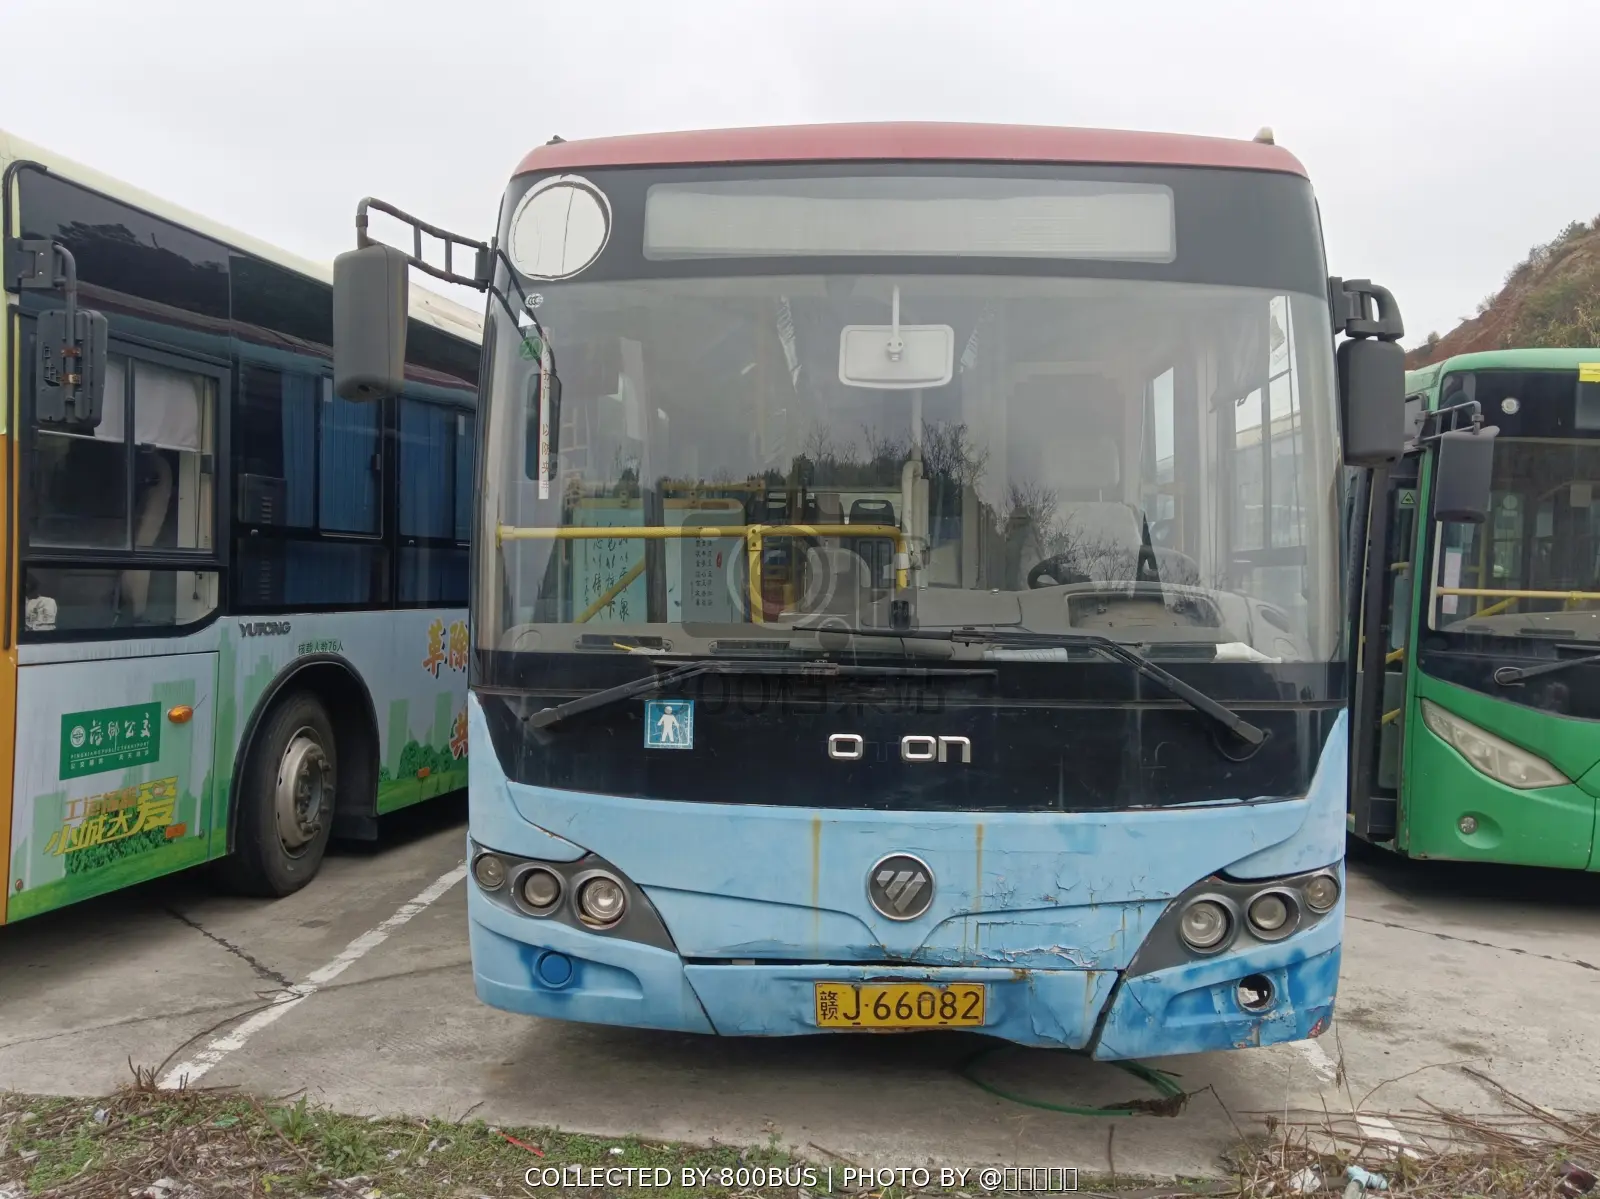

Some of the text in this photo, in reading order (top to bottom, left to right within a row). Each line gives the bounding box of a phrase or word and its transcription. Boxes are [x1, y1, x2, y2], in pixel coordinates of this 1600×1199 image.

[239, 621, 291, 638] YUTONG
[43, 775, 179, 857] 小城大爱
